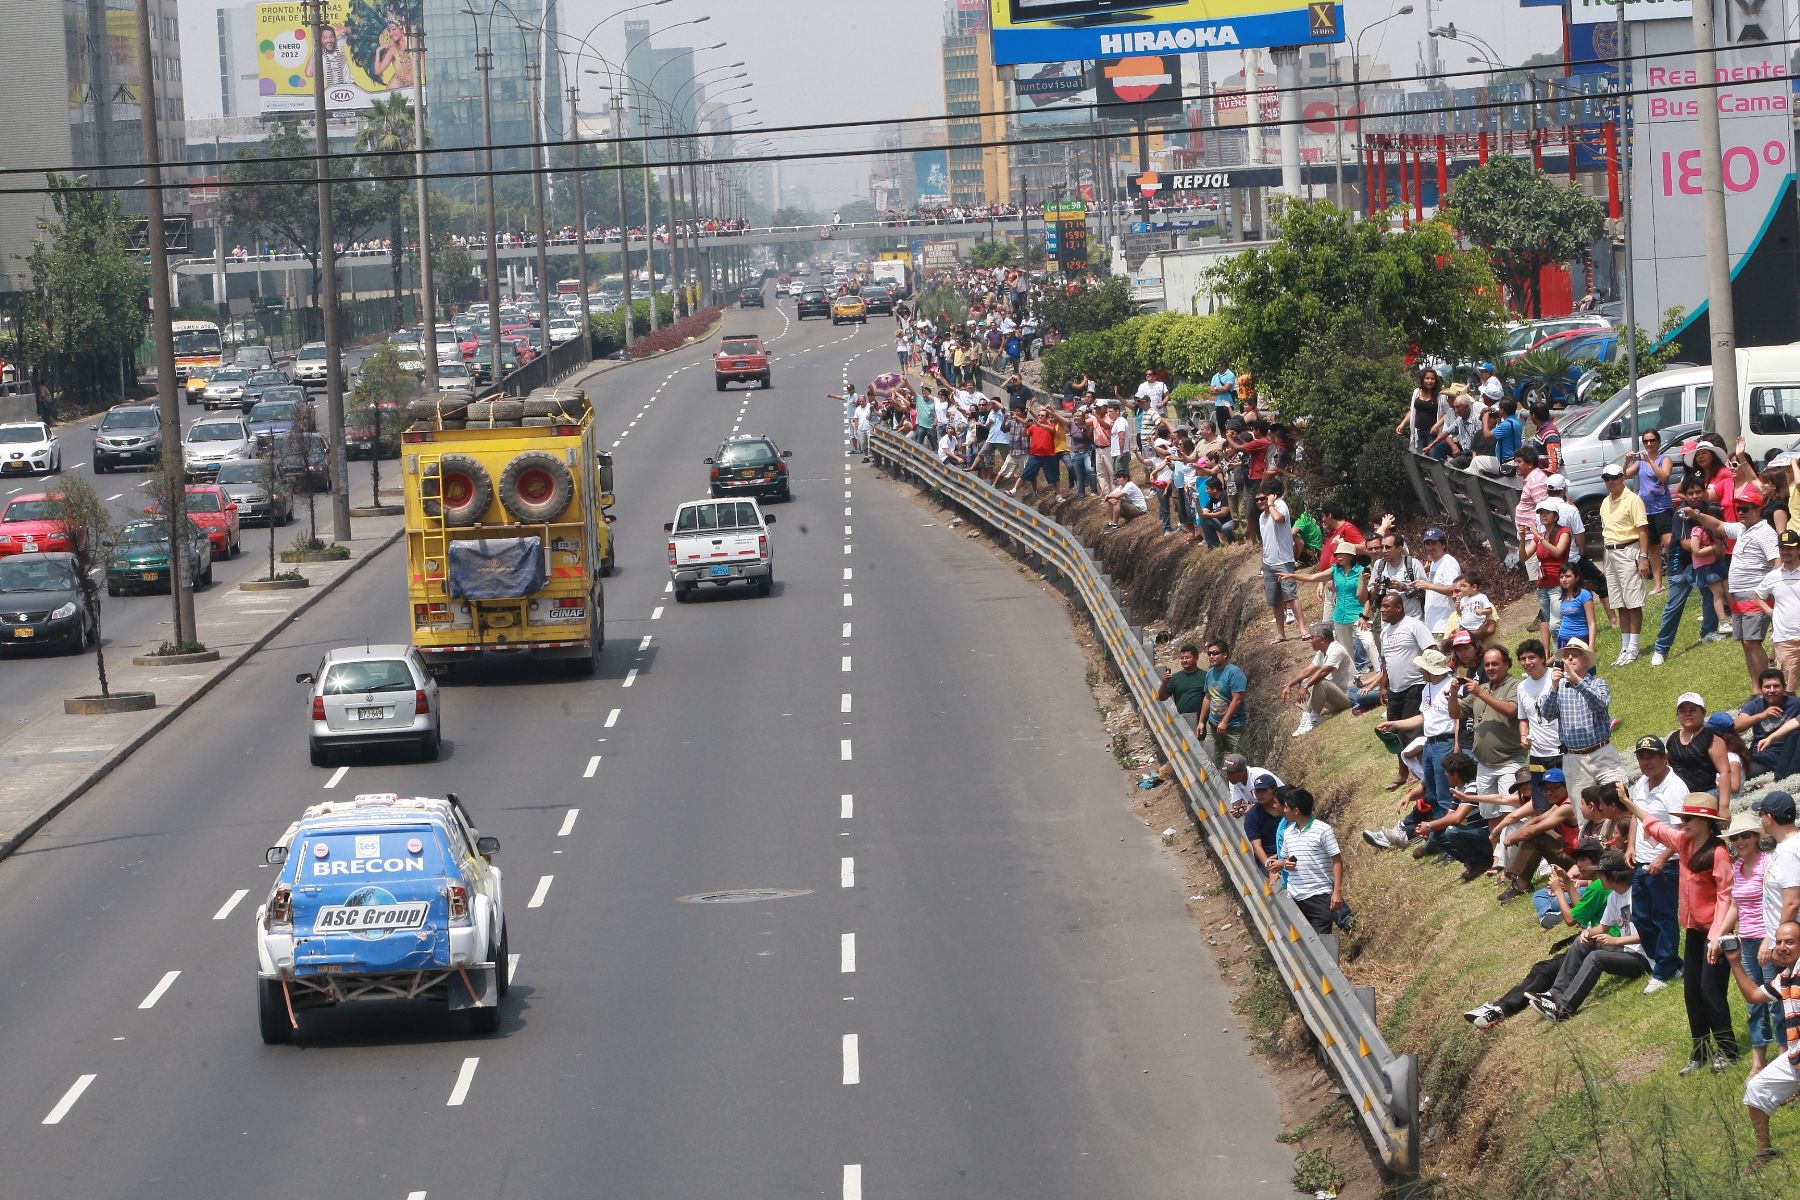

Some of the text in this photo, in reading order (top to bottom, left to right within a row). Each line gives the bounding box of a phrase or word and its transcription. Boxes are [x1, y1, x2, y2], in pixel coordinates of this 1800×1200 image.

[261, 6, 294, 14] PRONTO
[1312, 4, 1333, 28] X
[262, 15, 286, 23] DEJAR
[1100, 25, 1240, 54] HIRAOKA
[1312, 28, 1335, 36] SERIES
[1650, 60, 1785, 86] Reamente
[1016, 78, 1085, 93] puntovisual
[334, 91, 351, 100] KIA
[1650, 97, 1699, 118] Bus
[1717, 93, 1787, 113] Cama
[1173, 173, 1230, 189] REPSOL
[551, 609, 584, 619] GINAF
[360, 841, 376, 851] tes
[313, 857, 424, 876] BRECON
[320, 906, 421, 927] ASC Group
